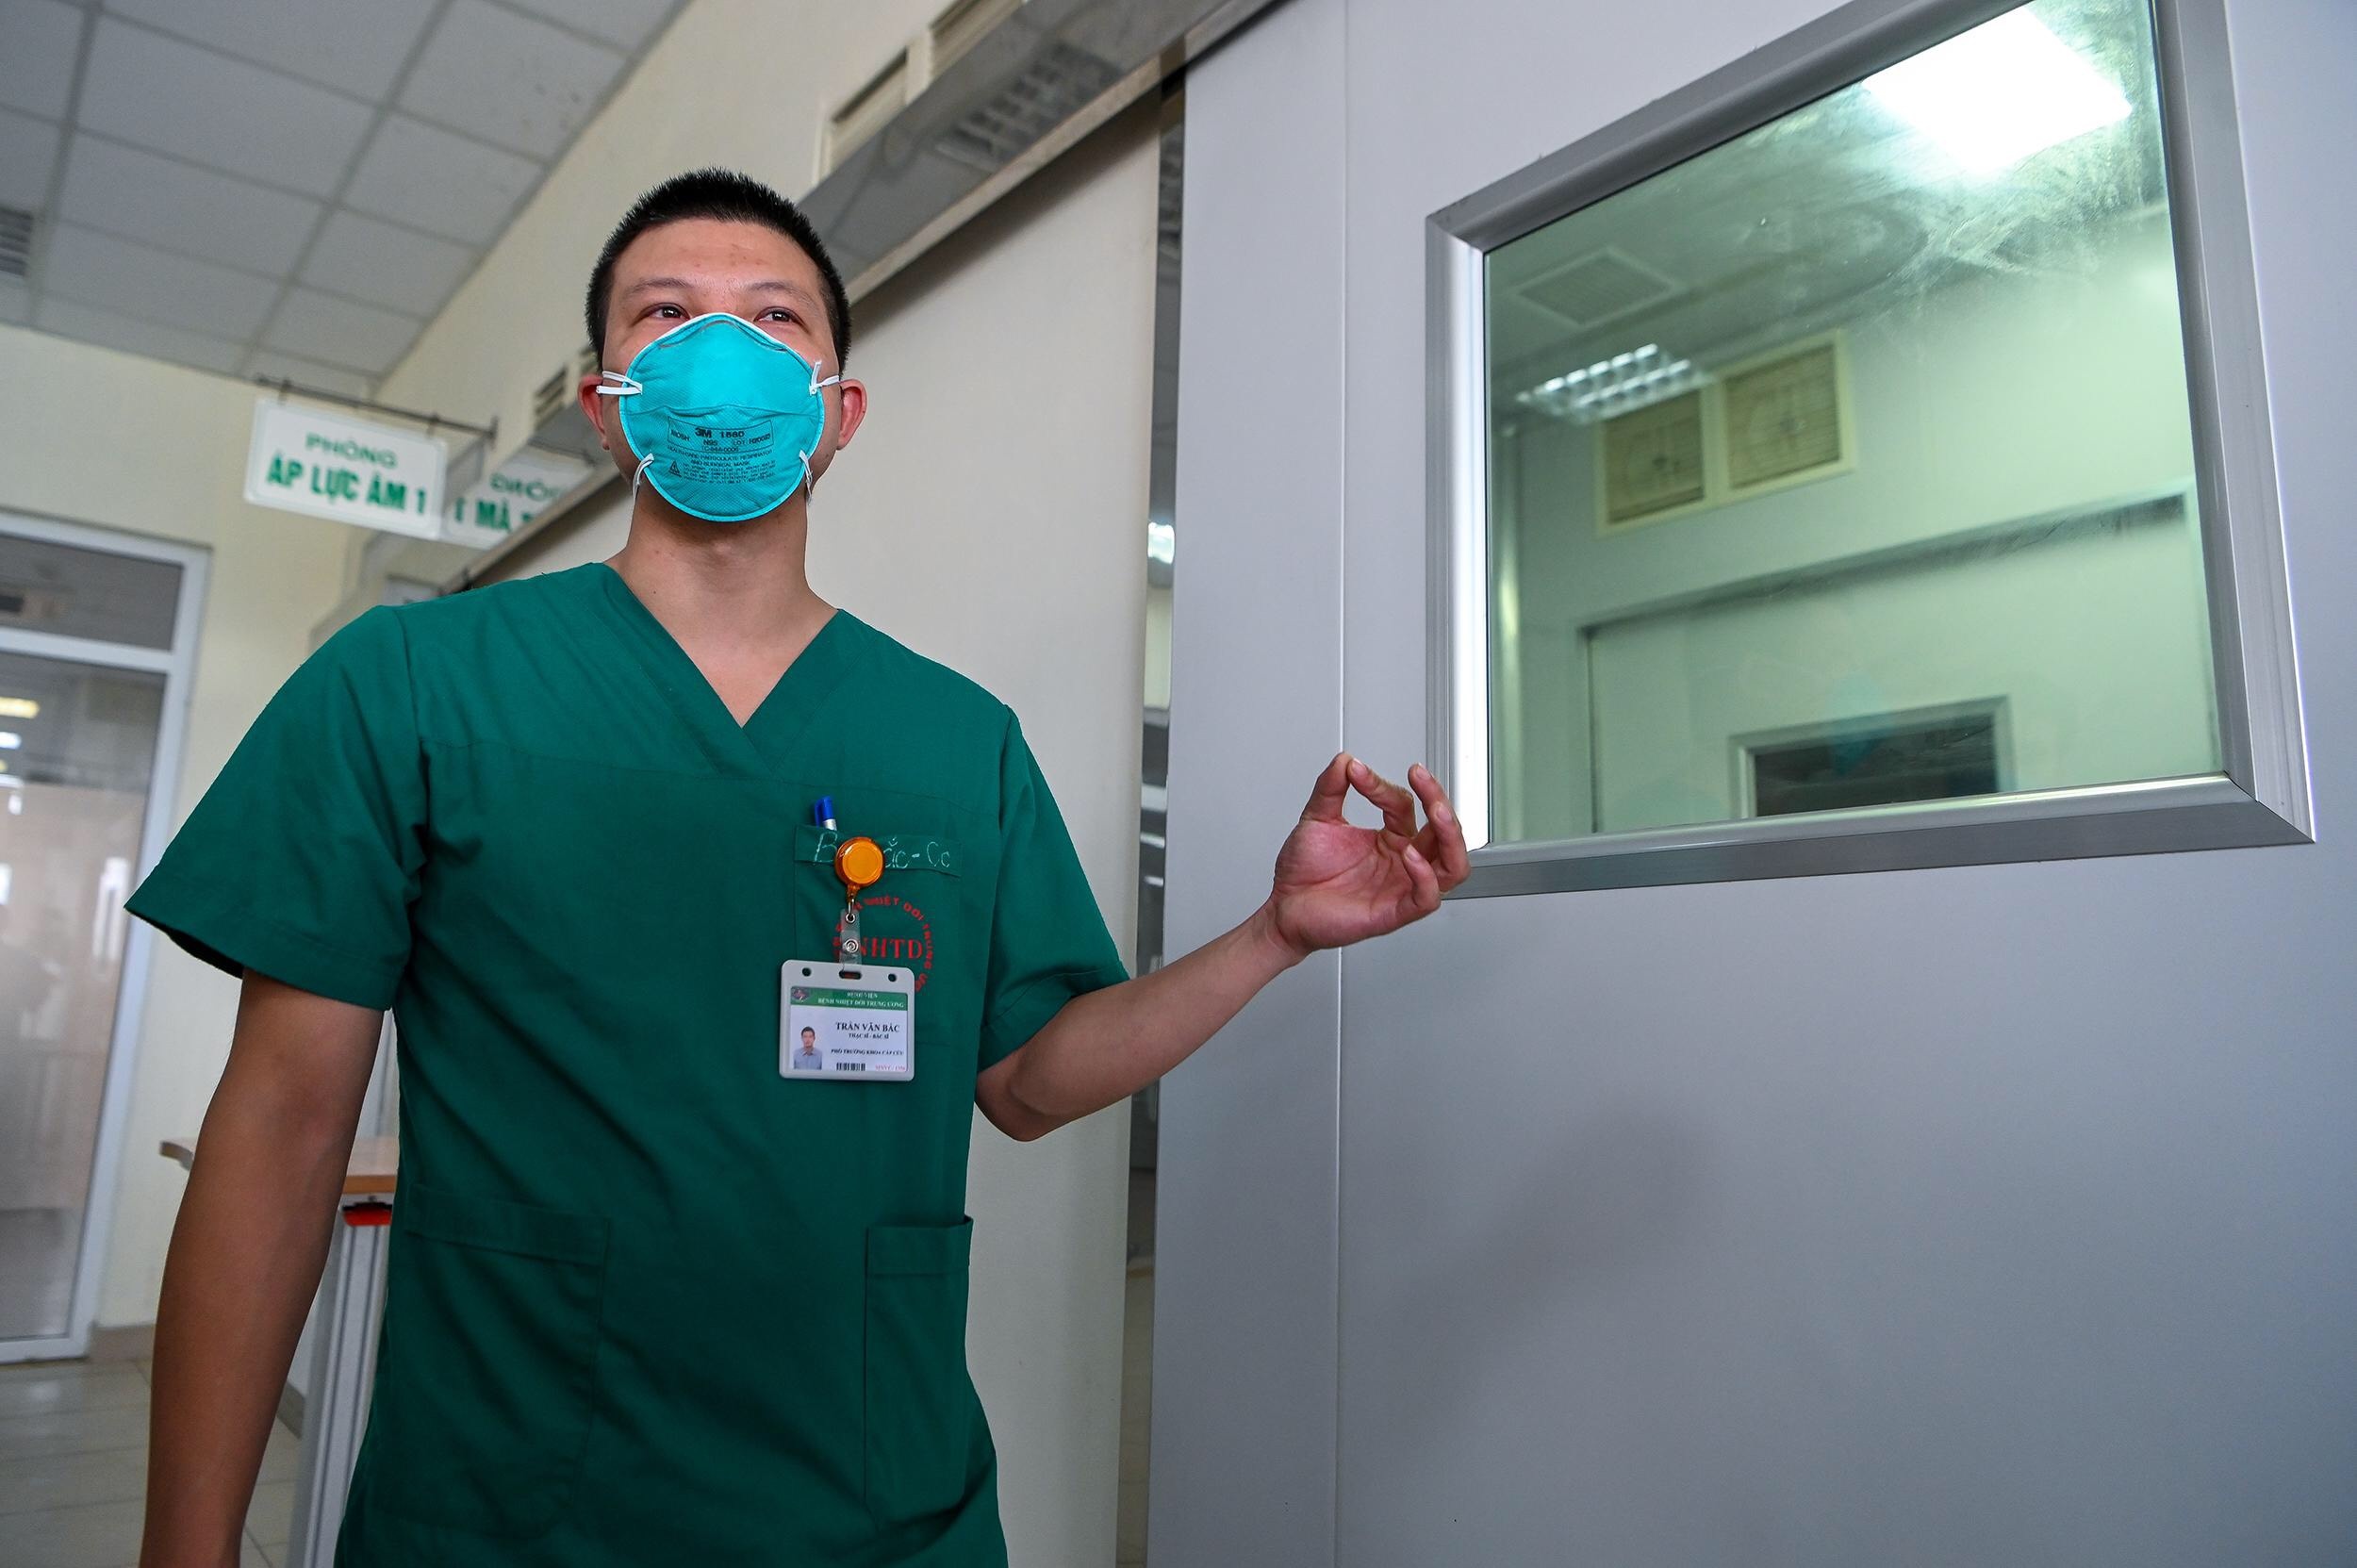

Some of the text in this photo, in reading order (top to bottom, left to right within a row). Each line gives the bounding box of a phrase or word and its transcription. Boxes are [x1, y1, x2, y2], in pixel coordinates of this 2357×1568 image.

[670, 429, 690, 441] NIOSH
[695, 427, 712, 438] 3M
[305, 432, 398, 469] PHÒNG
[417, 487, 427, 515] 1
[862, 1022, 881, 1032] VĂN
